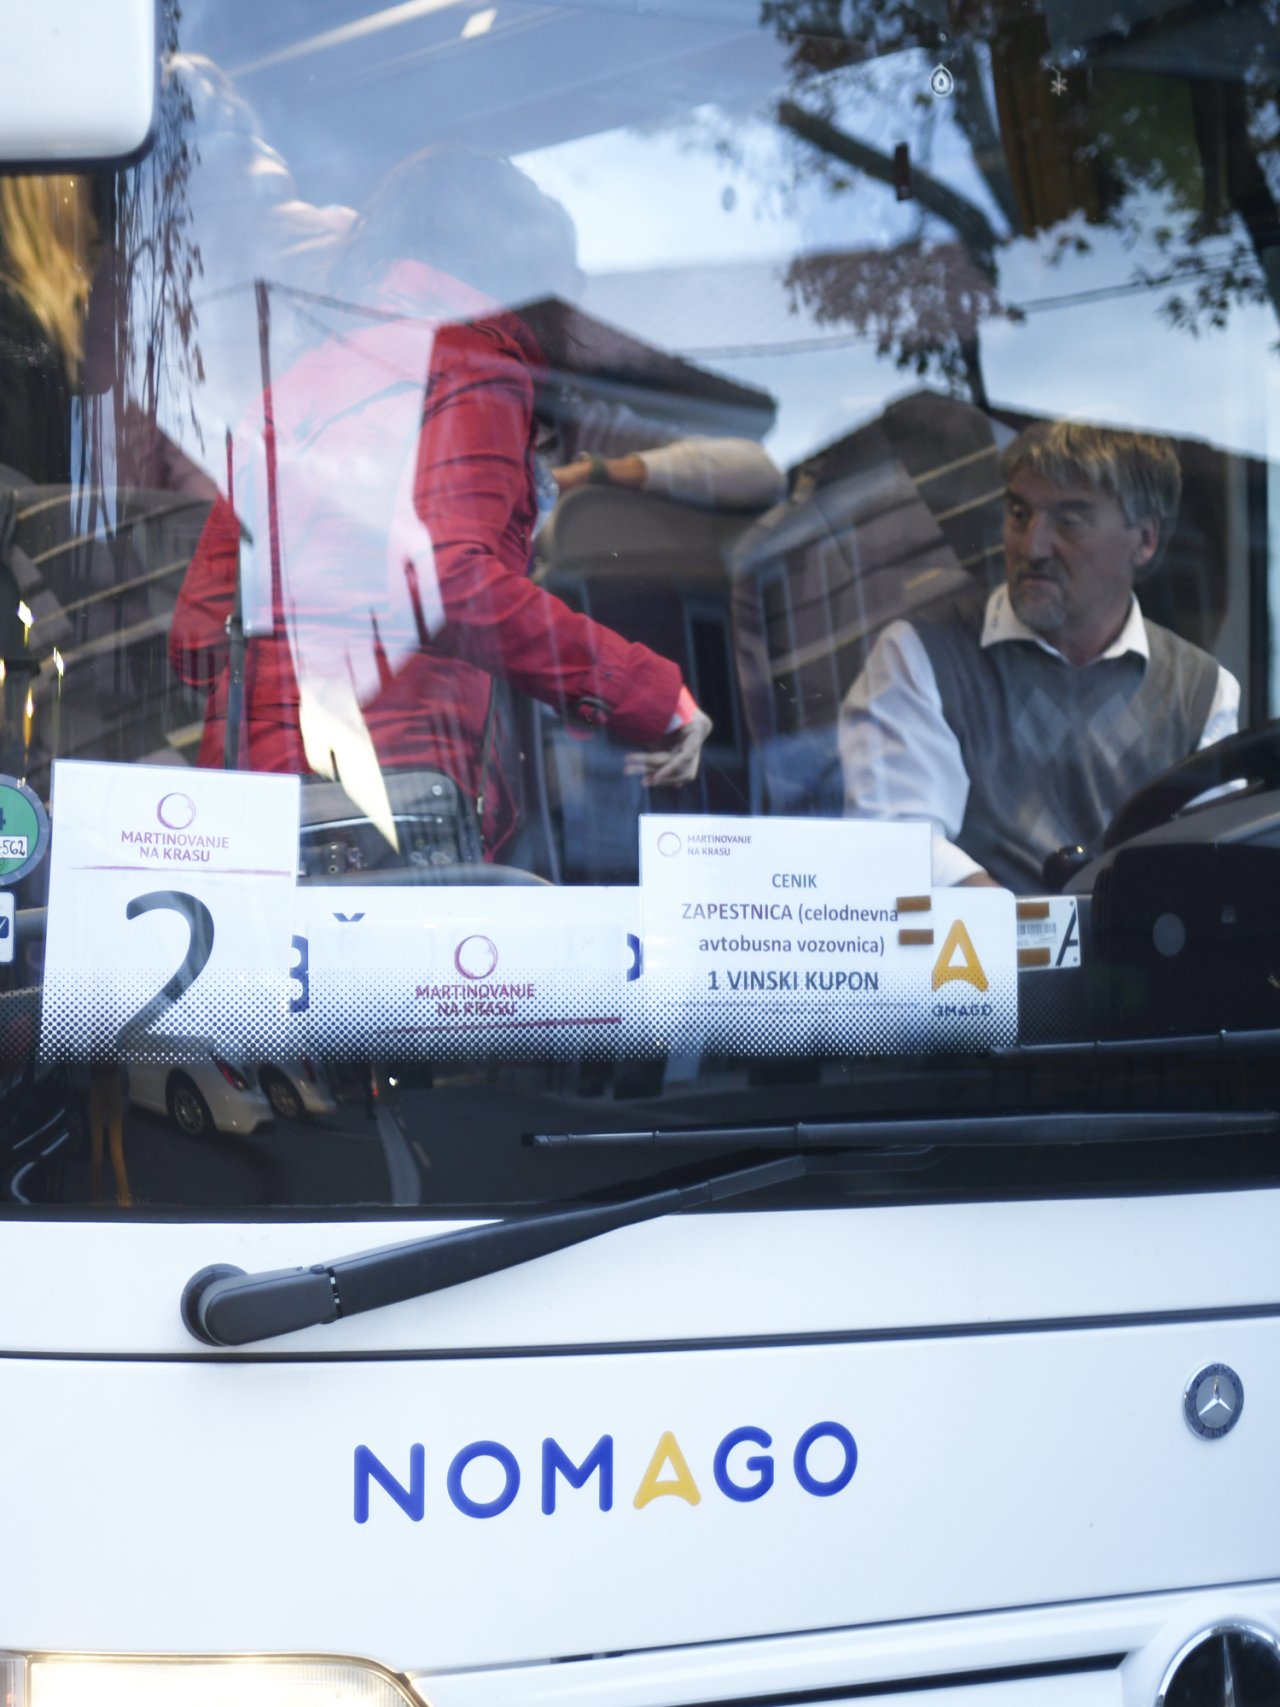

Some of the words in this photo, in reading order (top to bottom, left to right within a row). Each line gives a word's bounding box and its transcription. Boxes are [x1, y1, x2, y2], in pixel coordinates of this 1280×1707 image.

[121, 830, 229, 848] MARTINOVANJE
[687, 835, 752, 844] MARTINOVANJE
[140, 846, 159, 859] NA
[163, 848, 210, 862] KRASU
[687, 847, 700, 856] NA
[702, 847, 731, 856] KRASU
[771, 873, 817, 888] CENIK
[681, 903, 793, 920] ZAPESTNICA
[798, 903, 898, 924] (celodnevna
[699, 935, 792, 952] avtobusna
[797, 936, 885, 957] vozovnica)
[115, 890, 218, 1060] 2
[708, 971, 719, 991] 1
[727, 971, 798, 991] VINSKI
[805, 971, 879, 991] KUPON
[416, 984, 535, 999] MARTINOVANJE
[437, 1001, 460, 1016] NA
[463, 1001, 515, 1016] KRASU
[353, 1420, 859, 1525] NOMAGO
